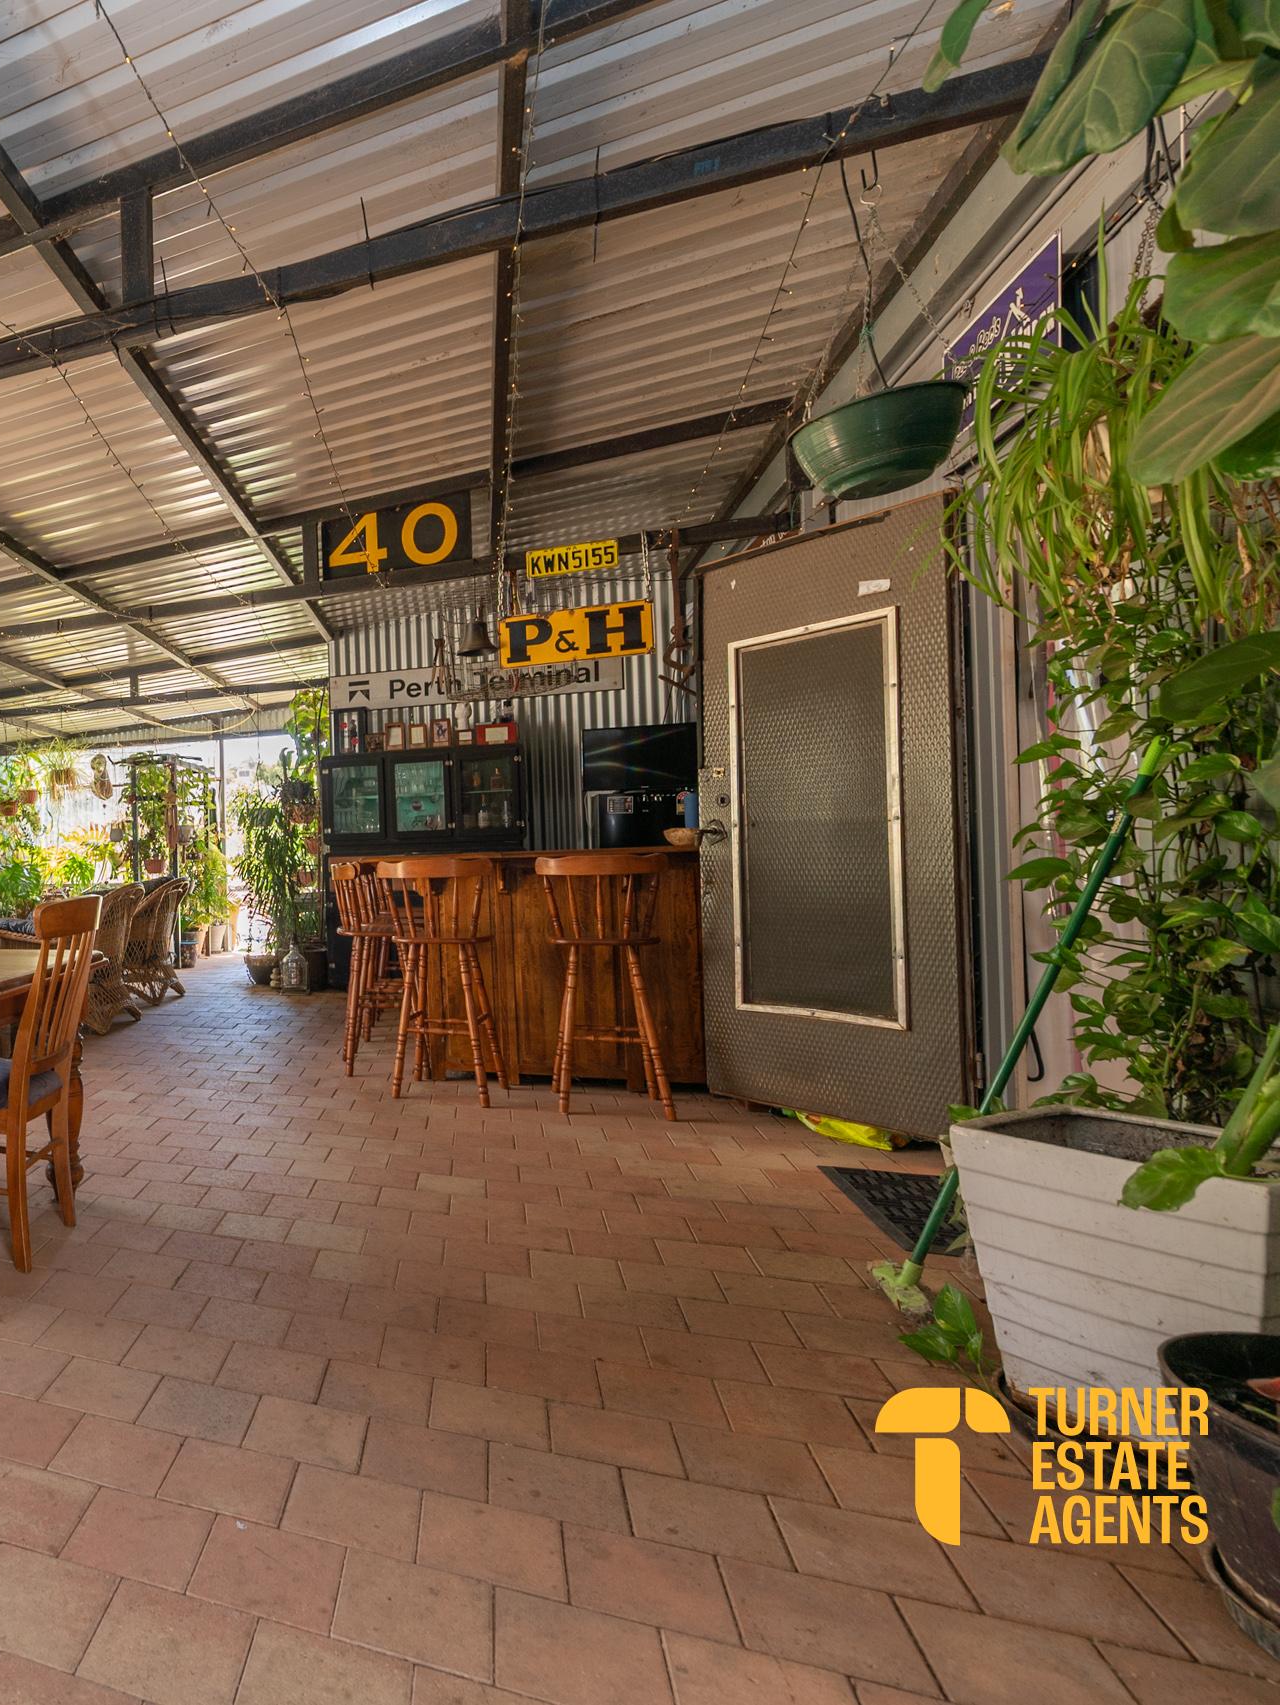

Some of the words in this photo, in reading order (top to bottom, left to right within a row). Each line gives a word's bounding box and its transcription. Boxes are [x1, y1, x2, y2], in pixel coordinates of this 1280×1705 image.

[329, 502, 458, 573] 40
[531, 545, 614, 575] KWN5155
[507, 605, 646, 664] P&H
